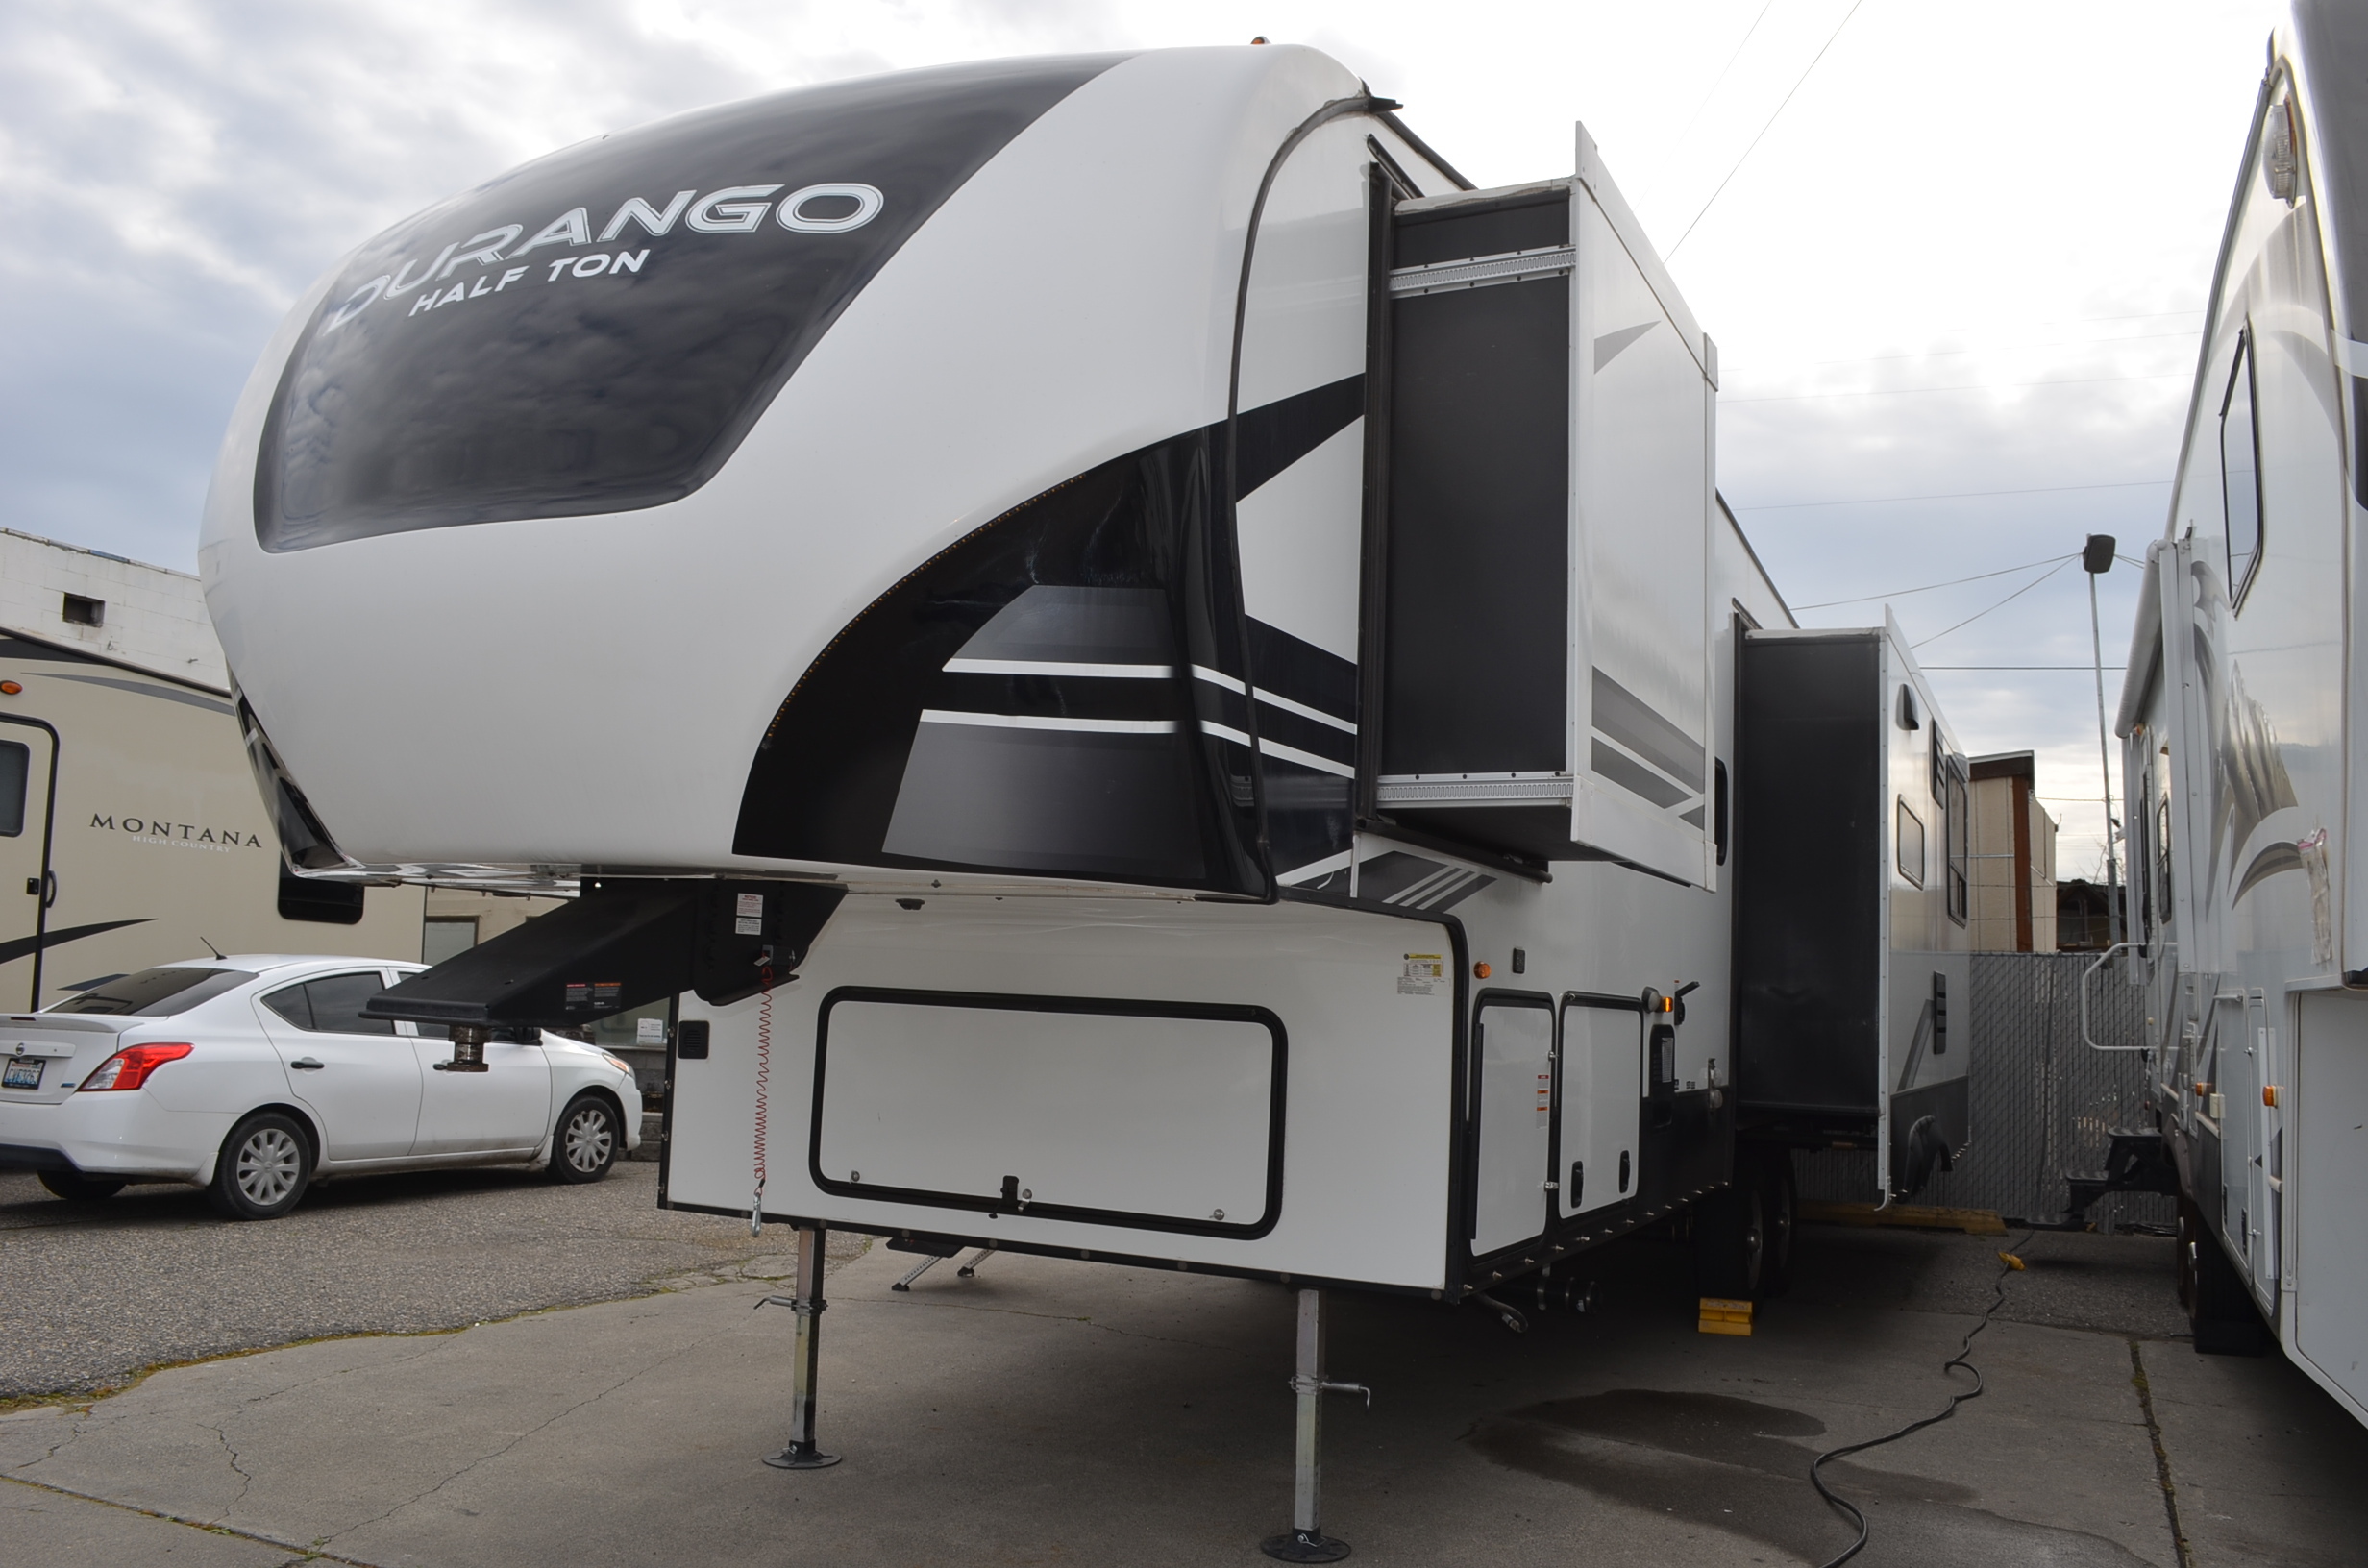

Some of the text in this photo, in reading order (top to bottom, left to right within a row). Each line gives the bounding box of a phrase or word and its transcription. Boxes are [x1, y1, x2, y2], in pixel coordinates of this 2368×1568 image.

[322, 182, 885, 337] DURANGO
[407, 248, 652, 318] HALF TON
[89, 813, 262, 849] MONTANA
[132, 834, 232, 853] HIGH COUNTRY
